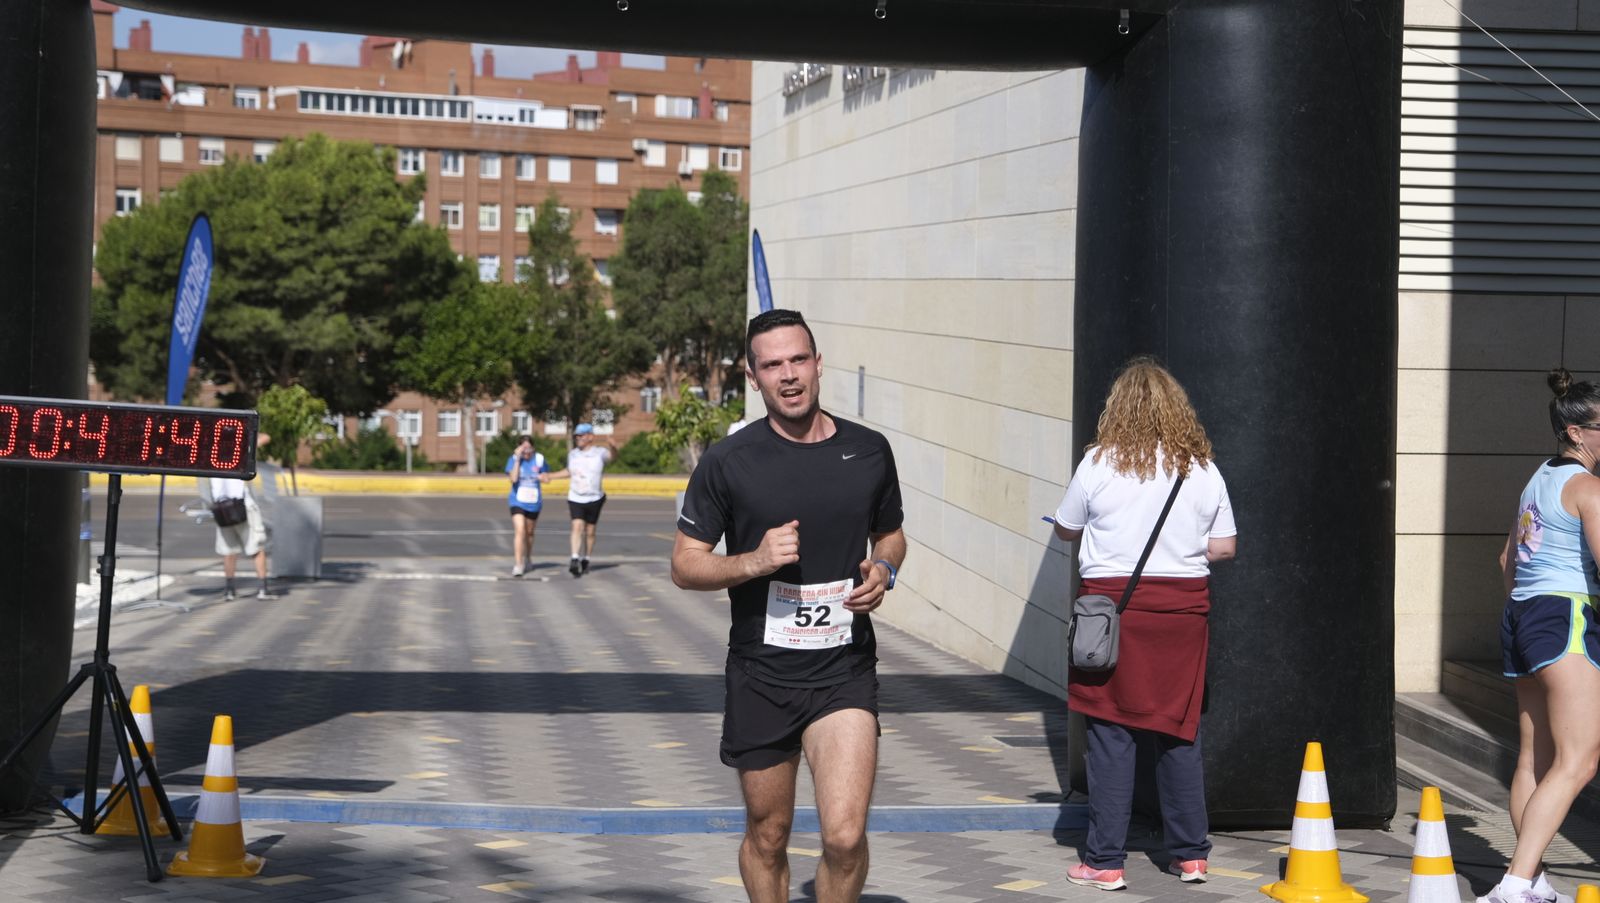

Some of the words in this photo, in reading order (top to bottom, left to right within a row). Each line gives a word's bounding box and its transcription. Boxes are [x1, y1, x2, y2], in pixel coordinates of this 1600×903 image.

[794, 605, 831, 627] 52
[783, 627, 818, 635] FRANCISCO
[819, 625, 839, 634] JAVIER
